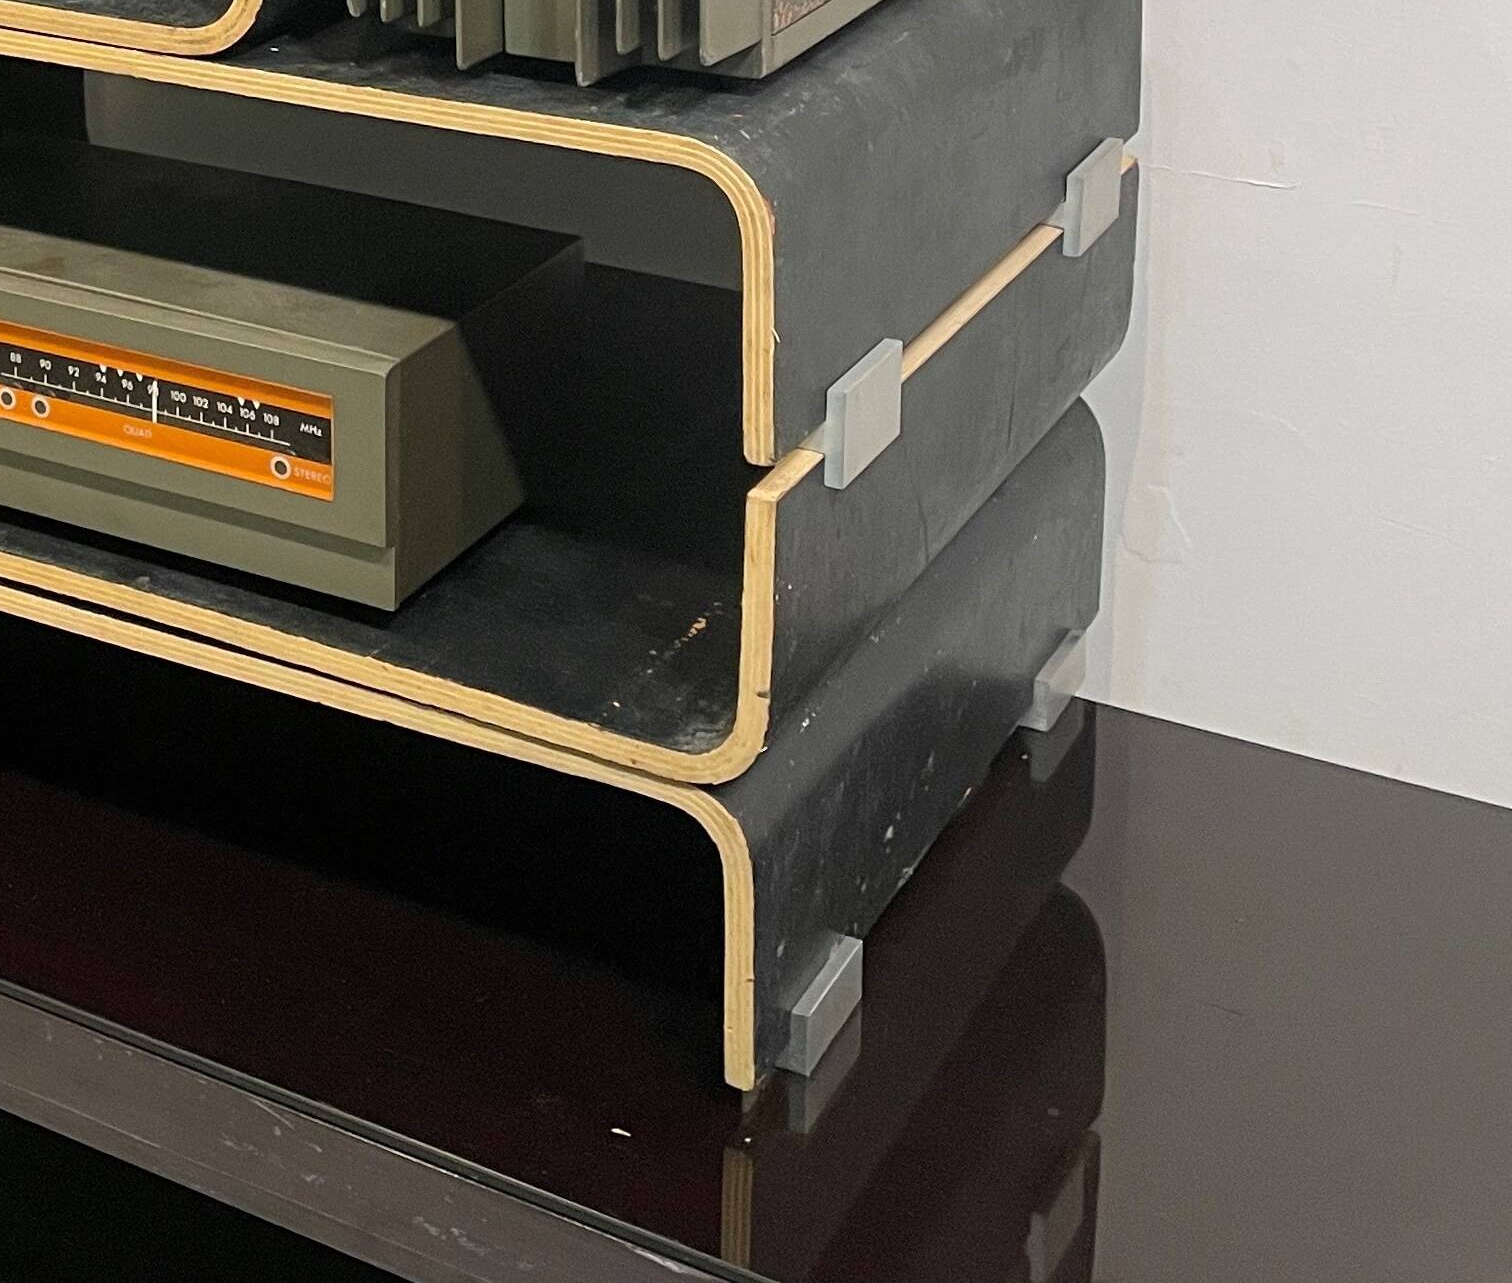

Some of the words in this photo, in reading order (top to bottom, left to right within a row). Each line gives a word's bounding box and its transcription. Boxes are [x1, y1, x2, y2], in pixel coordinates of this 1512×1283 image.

[9, 352, 22, 364] 88
[39, 359, 52, 371] 90
[67, 366, 80, 377] 92
[95, 372, 107, 384] 94
[121, 378, 134, 391] 96
[170, 390, 187, 403] 100
[192, 396, 209, 409] 102
[216, 401, 233, 415] 104
[239, 407, 256, 421] 106
[263, 412, 280, 426] 108
[299, 422, 323, 437] MHz
[123, 424, 152, 438] QUAD
